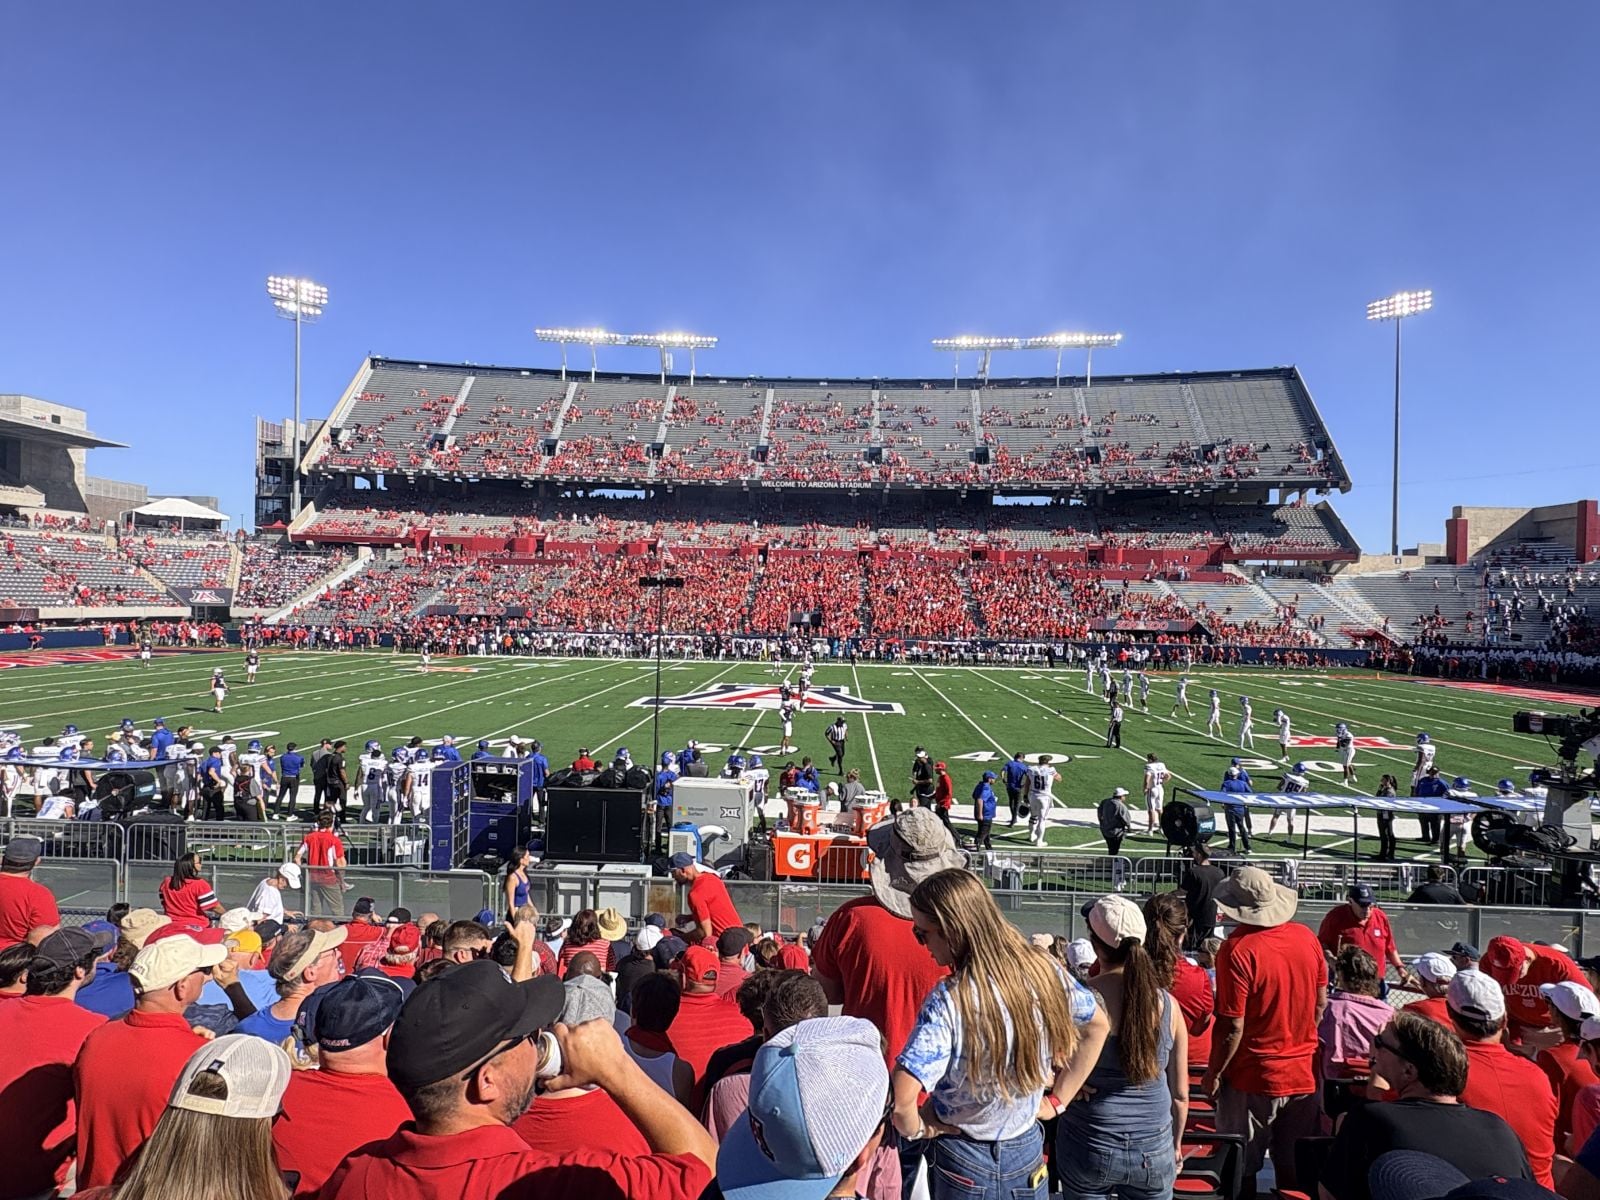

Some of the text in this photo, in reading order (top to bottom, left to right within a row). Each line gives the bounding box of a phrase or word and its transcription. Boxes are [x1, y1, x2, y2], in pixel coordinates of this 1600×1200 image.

[808, 481, 839, 489] ARIZONA
[949, 751, 1070, 764] 40
[418, 773, 429, 787] 14
[1033, 776, 1045, 790] 61
[803, 810, 813, 820] G
[863, 813, 873, 823] G
[787, 843, 811, 870] G
